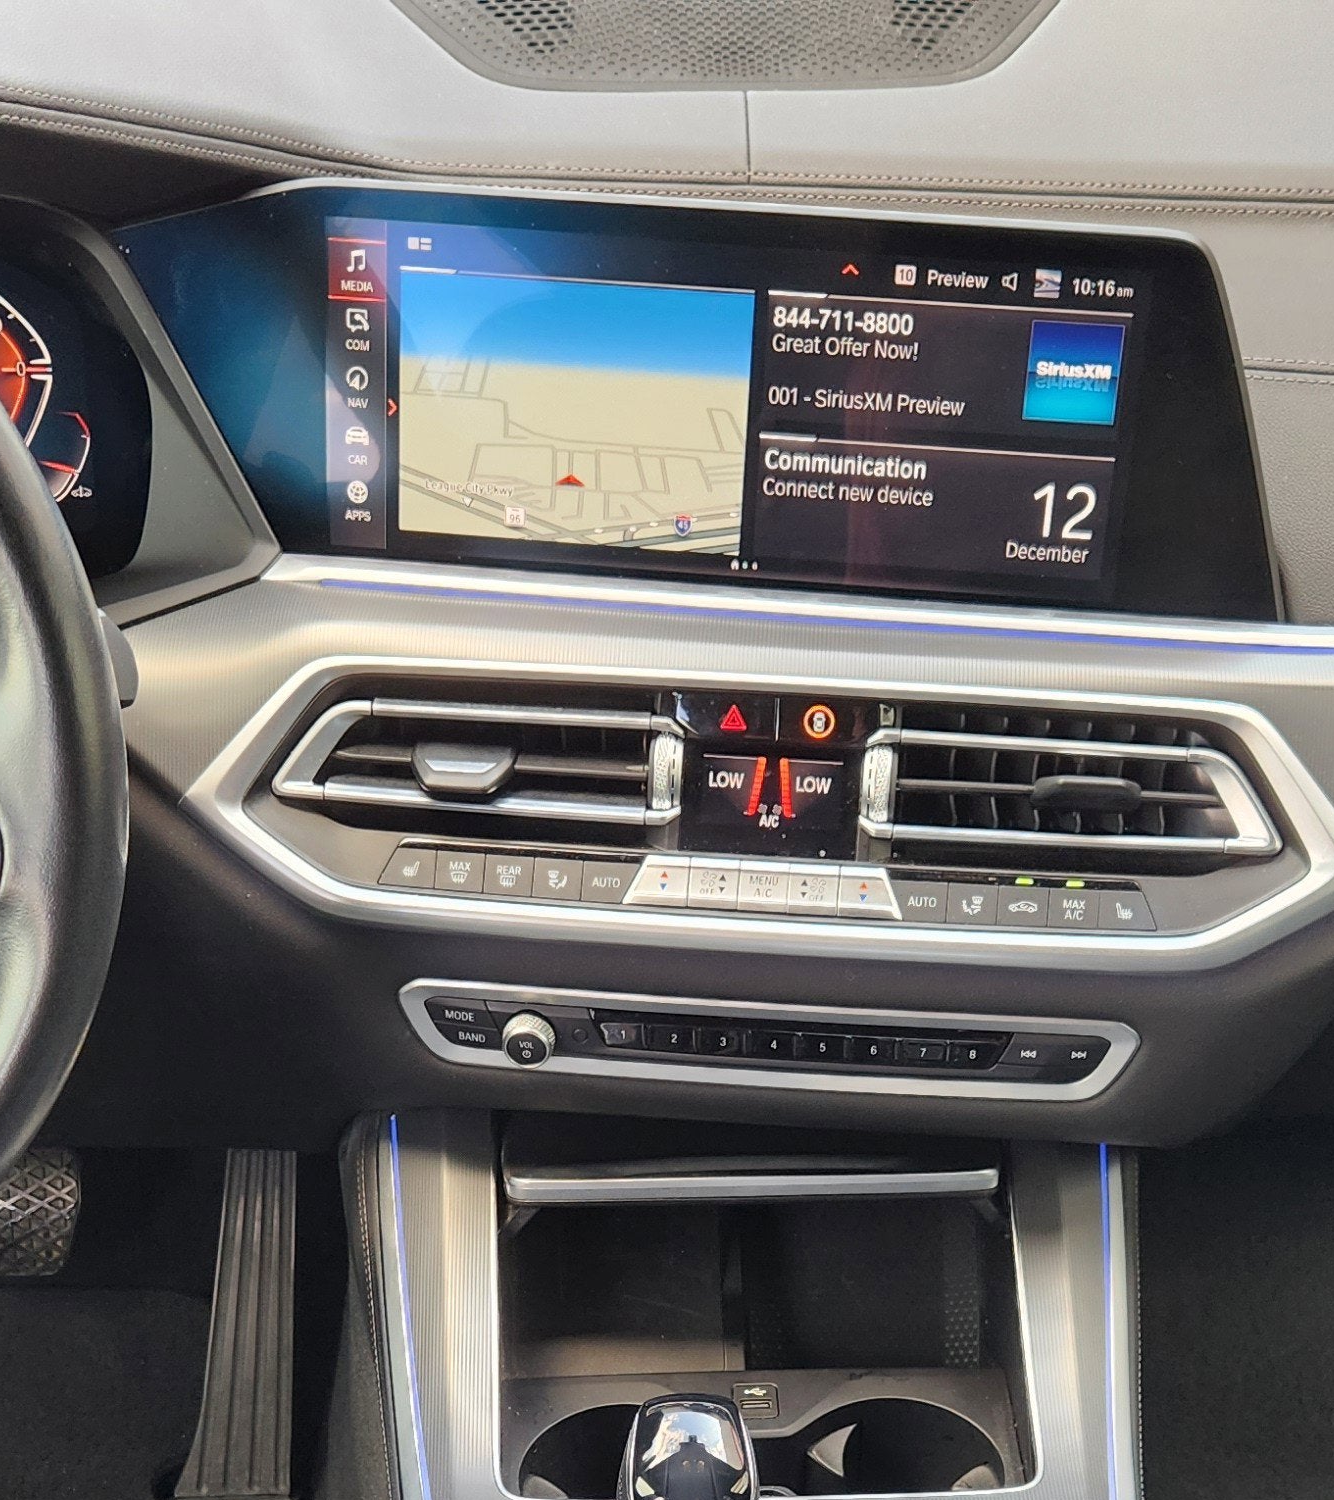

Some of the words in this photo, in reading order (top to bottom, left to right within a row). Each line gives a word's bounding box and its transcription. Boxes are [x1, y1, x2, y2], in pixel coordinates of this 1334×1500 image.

[898, 268, 913, 282] 10
[926, 269, 989, 289] Preview
[340, 279, 374, 293] MEDIA
[1072, 278, 1115, 297] 10:16
[772, 306, 914, 337] 844-711-8800
[345, 339, 370, 352] COM
[772, 334, 821, 354] Great
[824, 336, 870, 358] Offer
[874, 340, 919, 362] Now!
[16, 361, 26, 377] 0
[1036, 361, 1113, 381] SiriusXM
[347, 397, 368, 409] NAV
[768, 386, 798, 406] 001
[815, 388, 893, 413] SiriusXM
[896, 394, 965, 418] Preview
[347, 455, 368, 466] CAR
[764, 446, 928, 481] Communication
[425, 480, 462, 492] League
[466, 482, 485, 494] City
[487, 485, 513, 497] Pkwy
[762, 477, 835, 501] Connect
[838, 484, 873, 503] new
[877, 484, 934, 507] device
[345, 510, 371, 522] APPS
[1033, 481, 1097, 541] 12
[509, 514, 521, 523] 96
[1005, 540, 1090, 564] December
[708, 771, 745, 789] LOW
[795, 776, 832, 794] LOW
[758, 815, 780, 828] A/C
[449, 861, 471, 872] MAX
[496, 865, 522, 876] REAR
[592, 877, 621, 889] AUTO
[749, 875, 779, 886] MENU
[754, 888, 772, 898] A/C
[907, 896, 937, 908] AUTO
[1062, 899, 1086, 910] MAX
[1064, 910, 1084, 921] A/C
[445, 1009, 475, 1022] MODE
[458, 1031, 486, 1043] BAND
[620, 1029, 626, 1040] 1
[670, 1033, 678, 1044] 2
[518, 1040, 535, 1049] VOL
[719, 1036, 727, 1047] 3
[770, 1039, 778, 1050] 4
[819, 1042, 827, 1053] 5
[870, 1045, 877, 1056] 6
[919, 1047, 927, 1058] 7
[968, 1049, 976, 1060] 8
